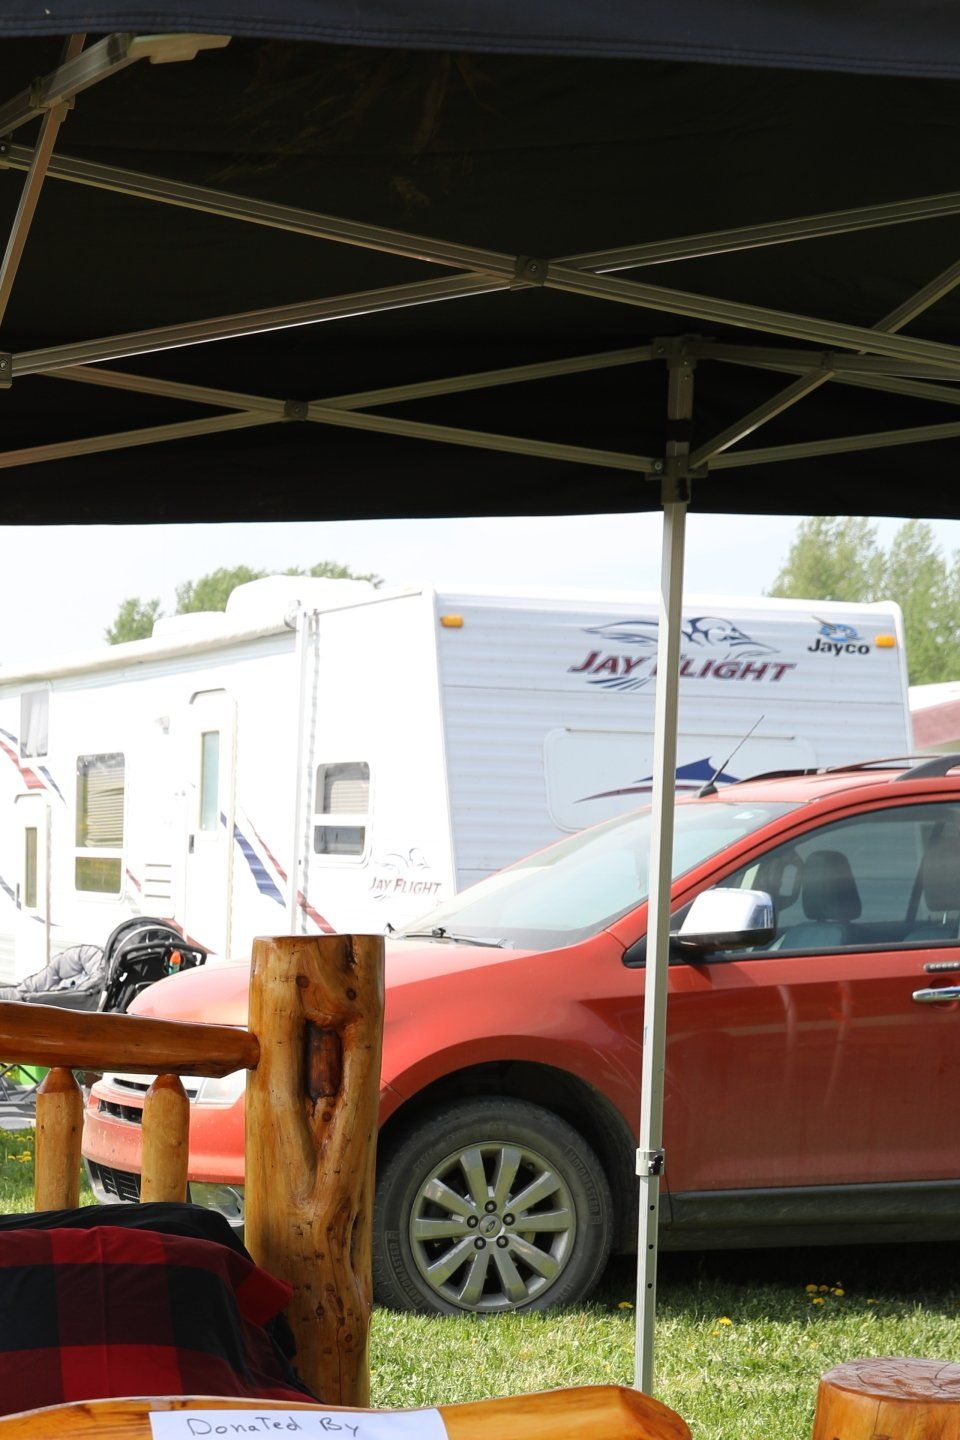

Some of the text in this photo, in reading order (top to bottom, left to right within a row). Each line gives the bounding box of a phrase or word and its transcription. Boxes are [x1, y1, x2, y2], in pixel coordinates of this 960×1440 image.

[808, 638, 871, 657] Jayco
[567, 650, 652, 676] JAY
[369, 877, 442, 895] JAY FLIGHT
[319, 1416, 361, 1437] By
